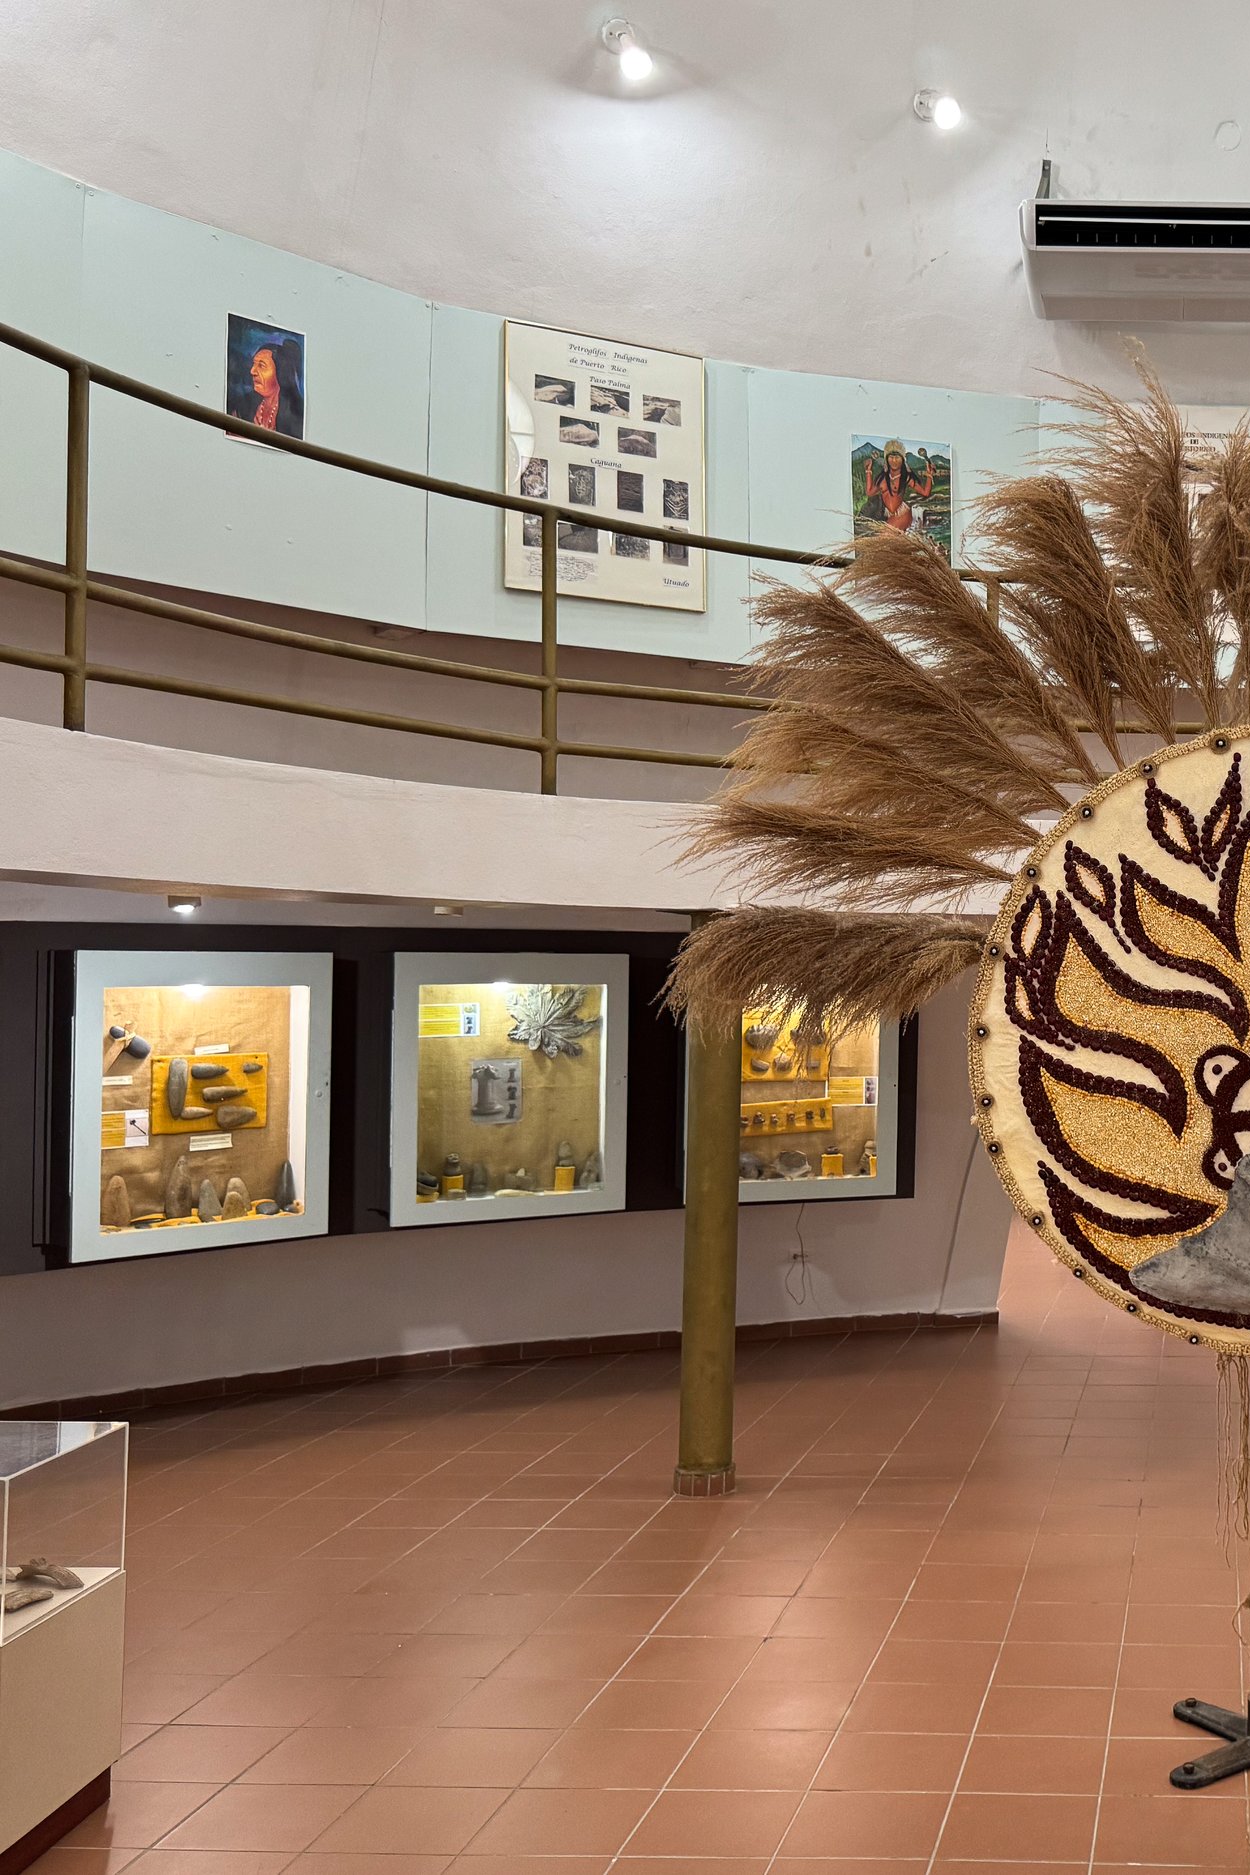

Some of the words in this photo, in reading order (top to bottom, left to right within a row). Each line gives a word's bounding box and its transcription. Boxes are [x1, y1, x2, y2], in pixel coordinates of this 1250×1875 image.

[580, 359, 605, 370] Puerto
[610, 364, 627, 373] Rico
[607, 380, 631, 390] Palma
[663, 578, 690, 588] Utuado
